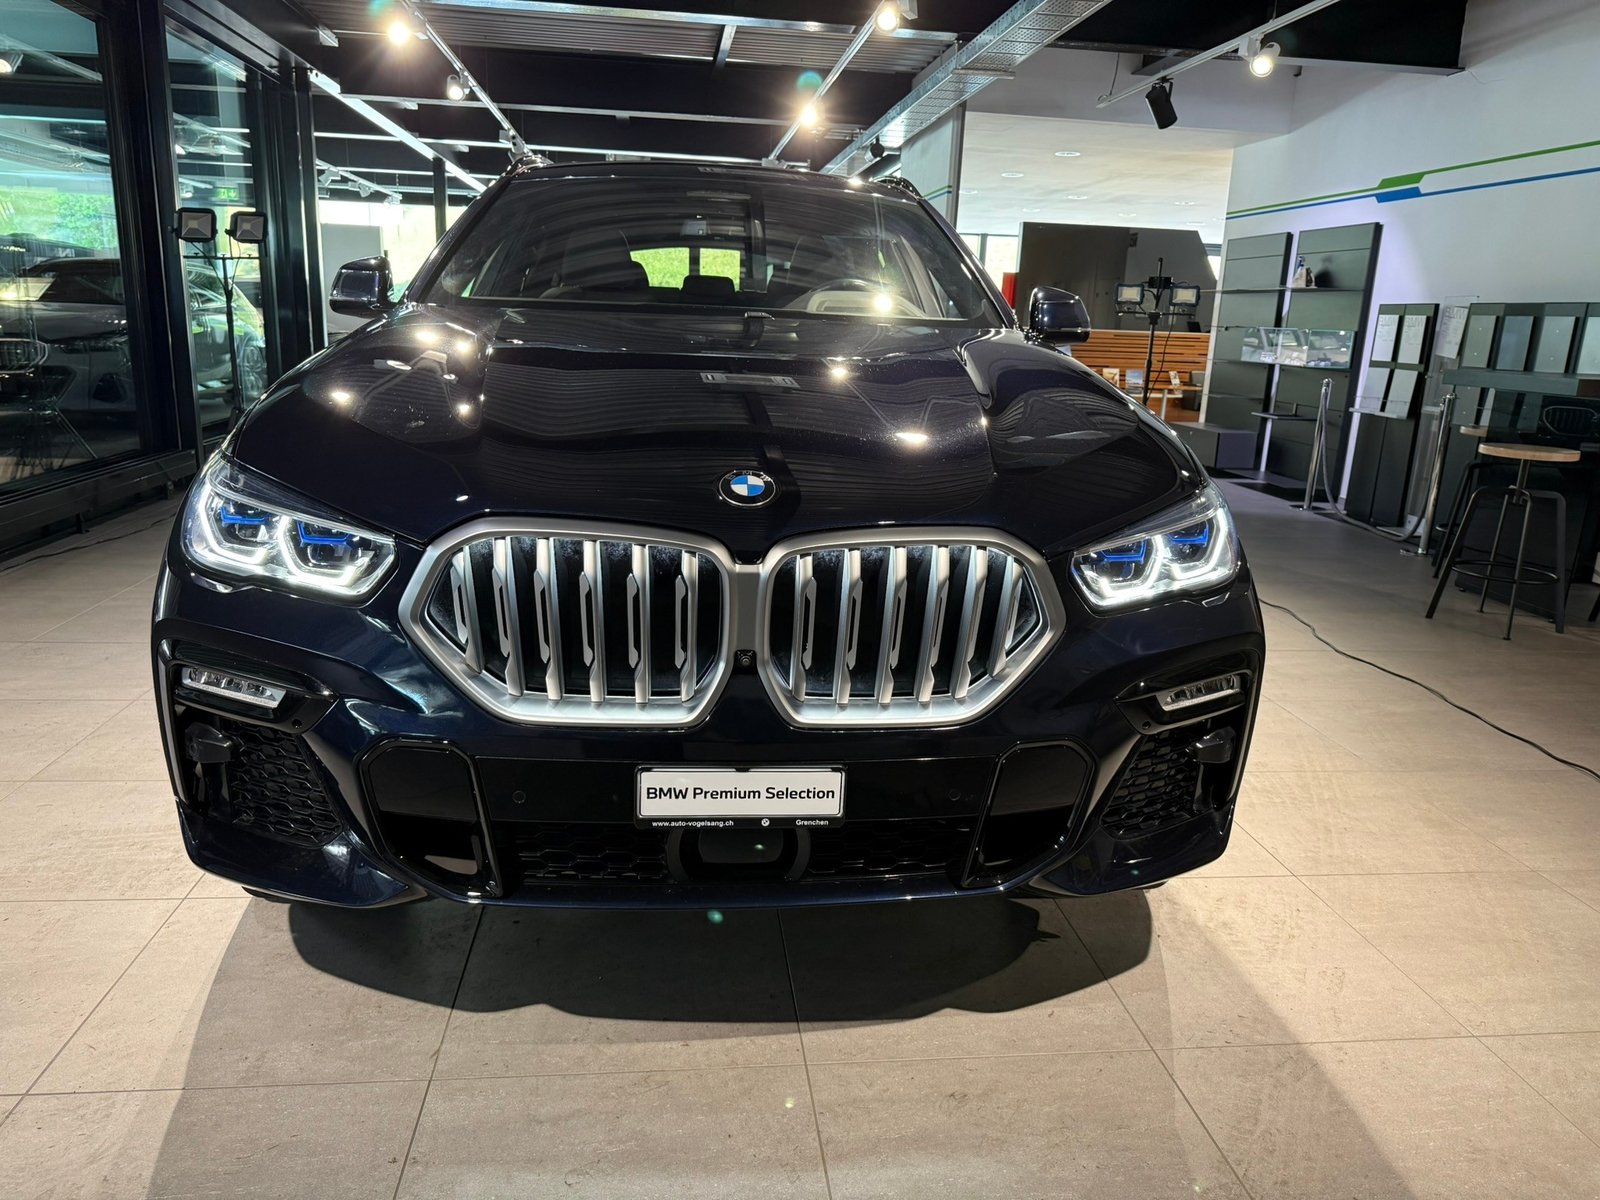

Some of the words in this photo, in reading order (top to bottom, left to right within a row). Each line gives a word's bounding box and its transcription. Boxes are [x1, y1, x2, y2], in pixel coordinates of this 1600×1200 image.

[646, 787, 688, 800] BMW
[692, 787, 761, 800] Premium
[765, 786, 835, 800] Selection
[651, 819, 734, 828] www.auto-vogelsang.ch
[795, 818, 829, 826] Grenchen
